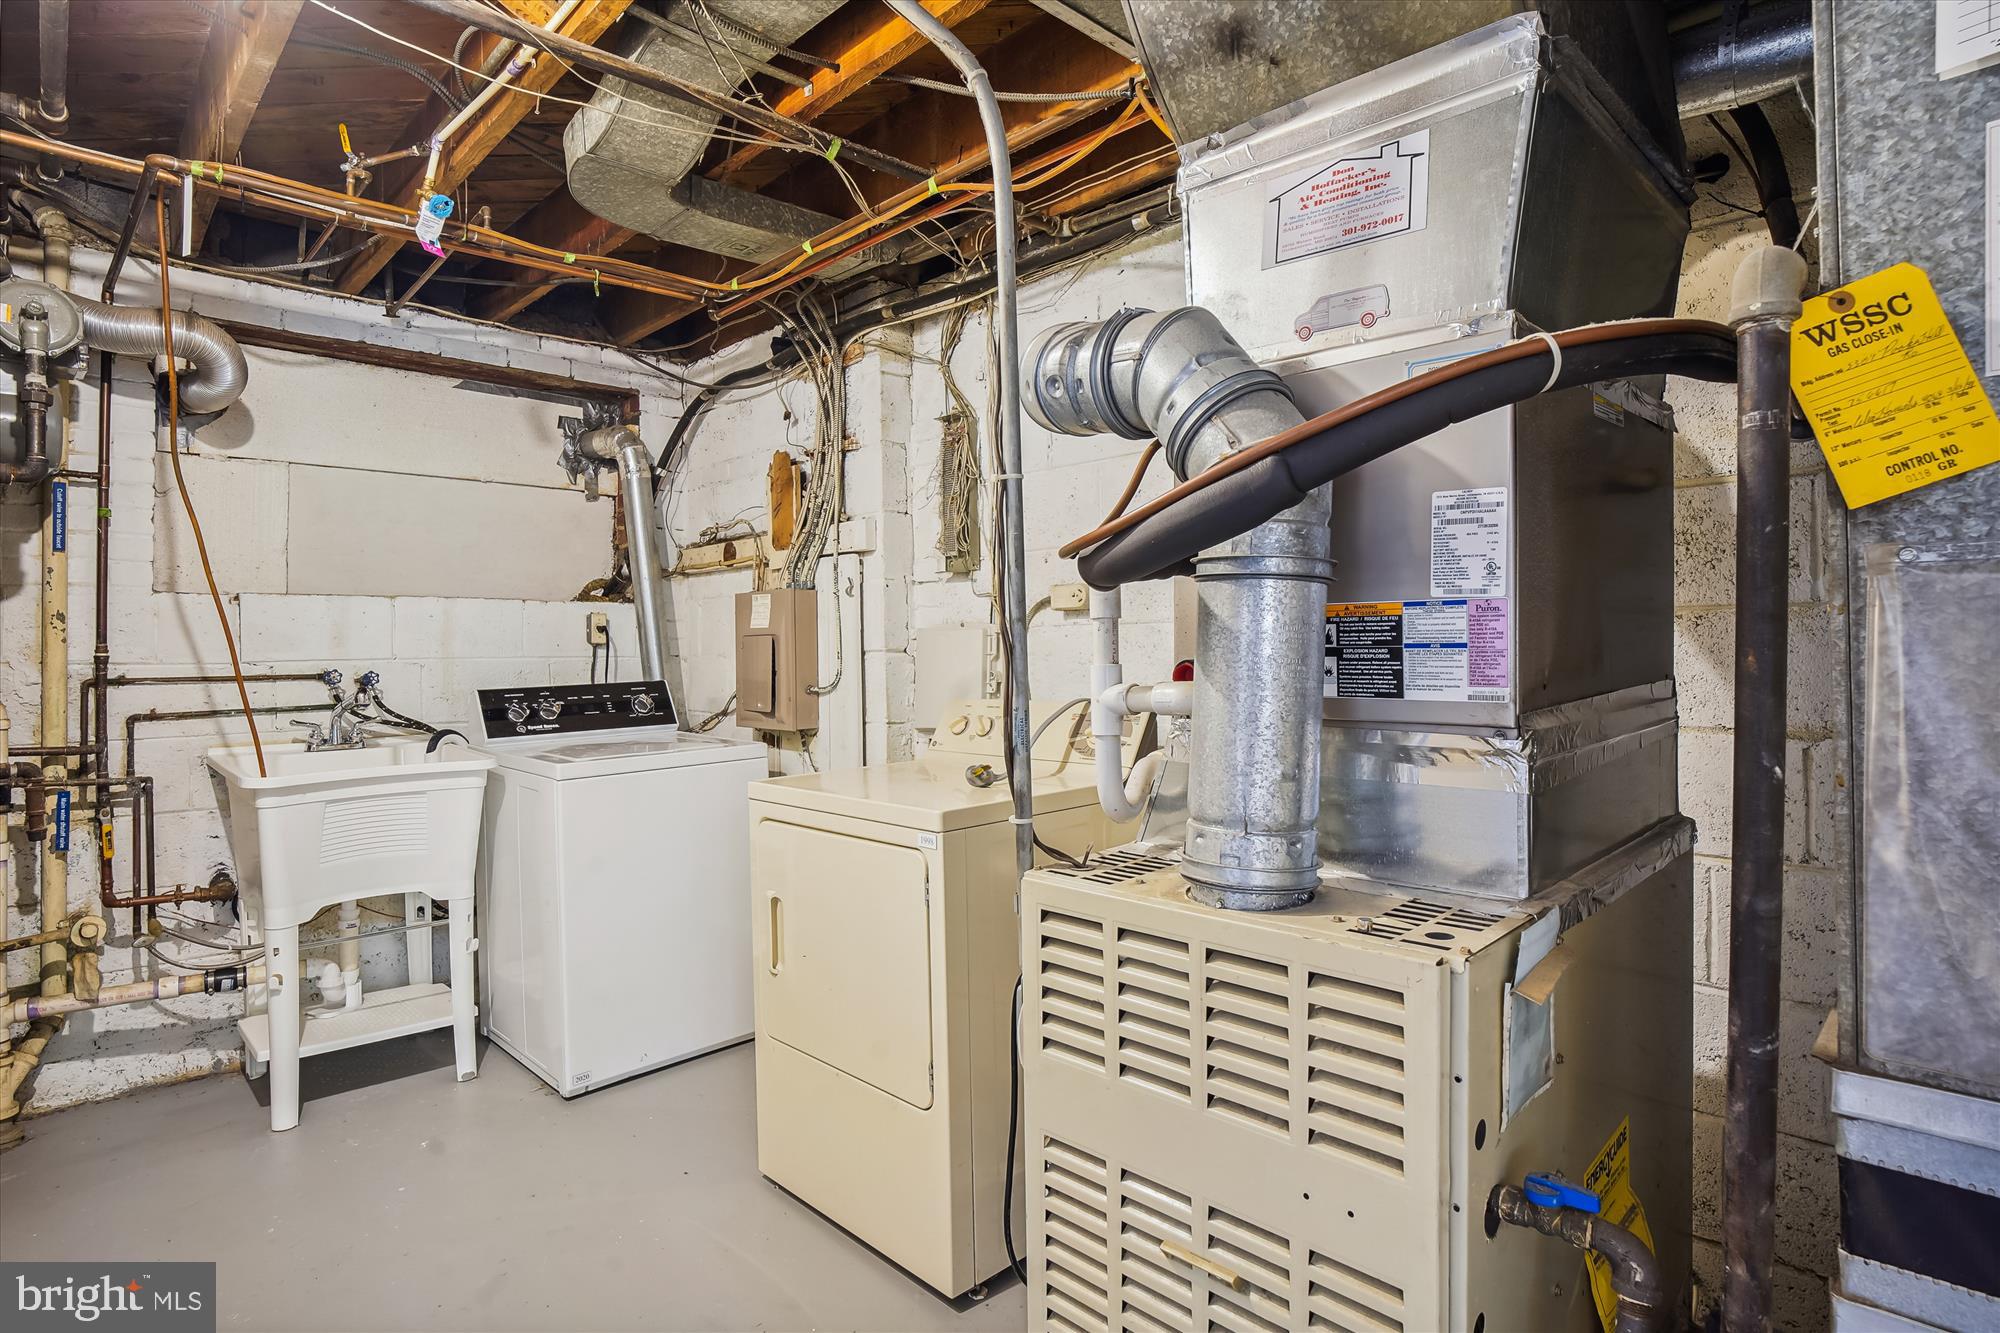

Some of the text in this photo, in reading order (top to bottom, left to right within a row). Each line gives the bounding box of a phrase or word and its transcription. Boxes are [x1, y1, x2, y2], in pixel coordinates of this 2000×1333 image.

[1332, 167, 1354, 176] Don
[1299, 171, 1391, 203] Air Conditioning
[1364, 182, 1386, 192] Inc.
[1283, 195, 1405, 233] SALES SERVICE INSTALLATIONS
[1342, 213, 1404, 237] 301-972-0017
[1800, 292, 1912, 347] WSSC
[1827, 322, 1904, 358] GAS CLOSE-IN
[1886, 444, 1964, 476] CONTROL NO.
[1938, 459, 1958, 470] GR
[576, 1074, 590, 1083] 2020
